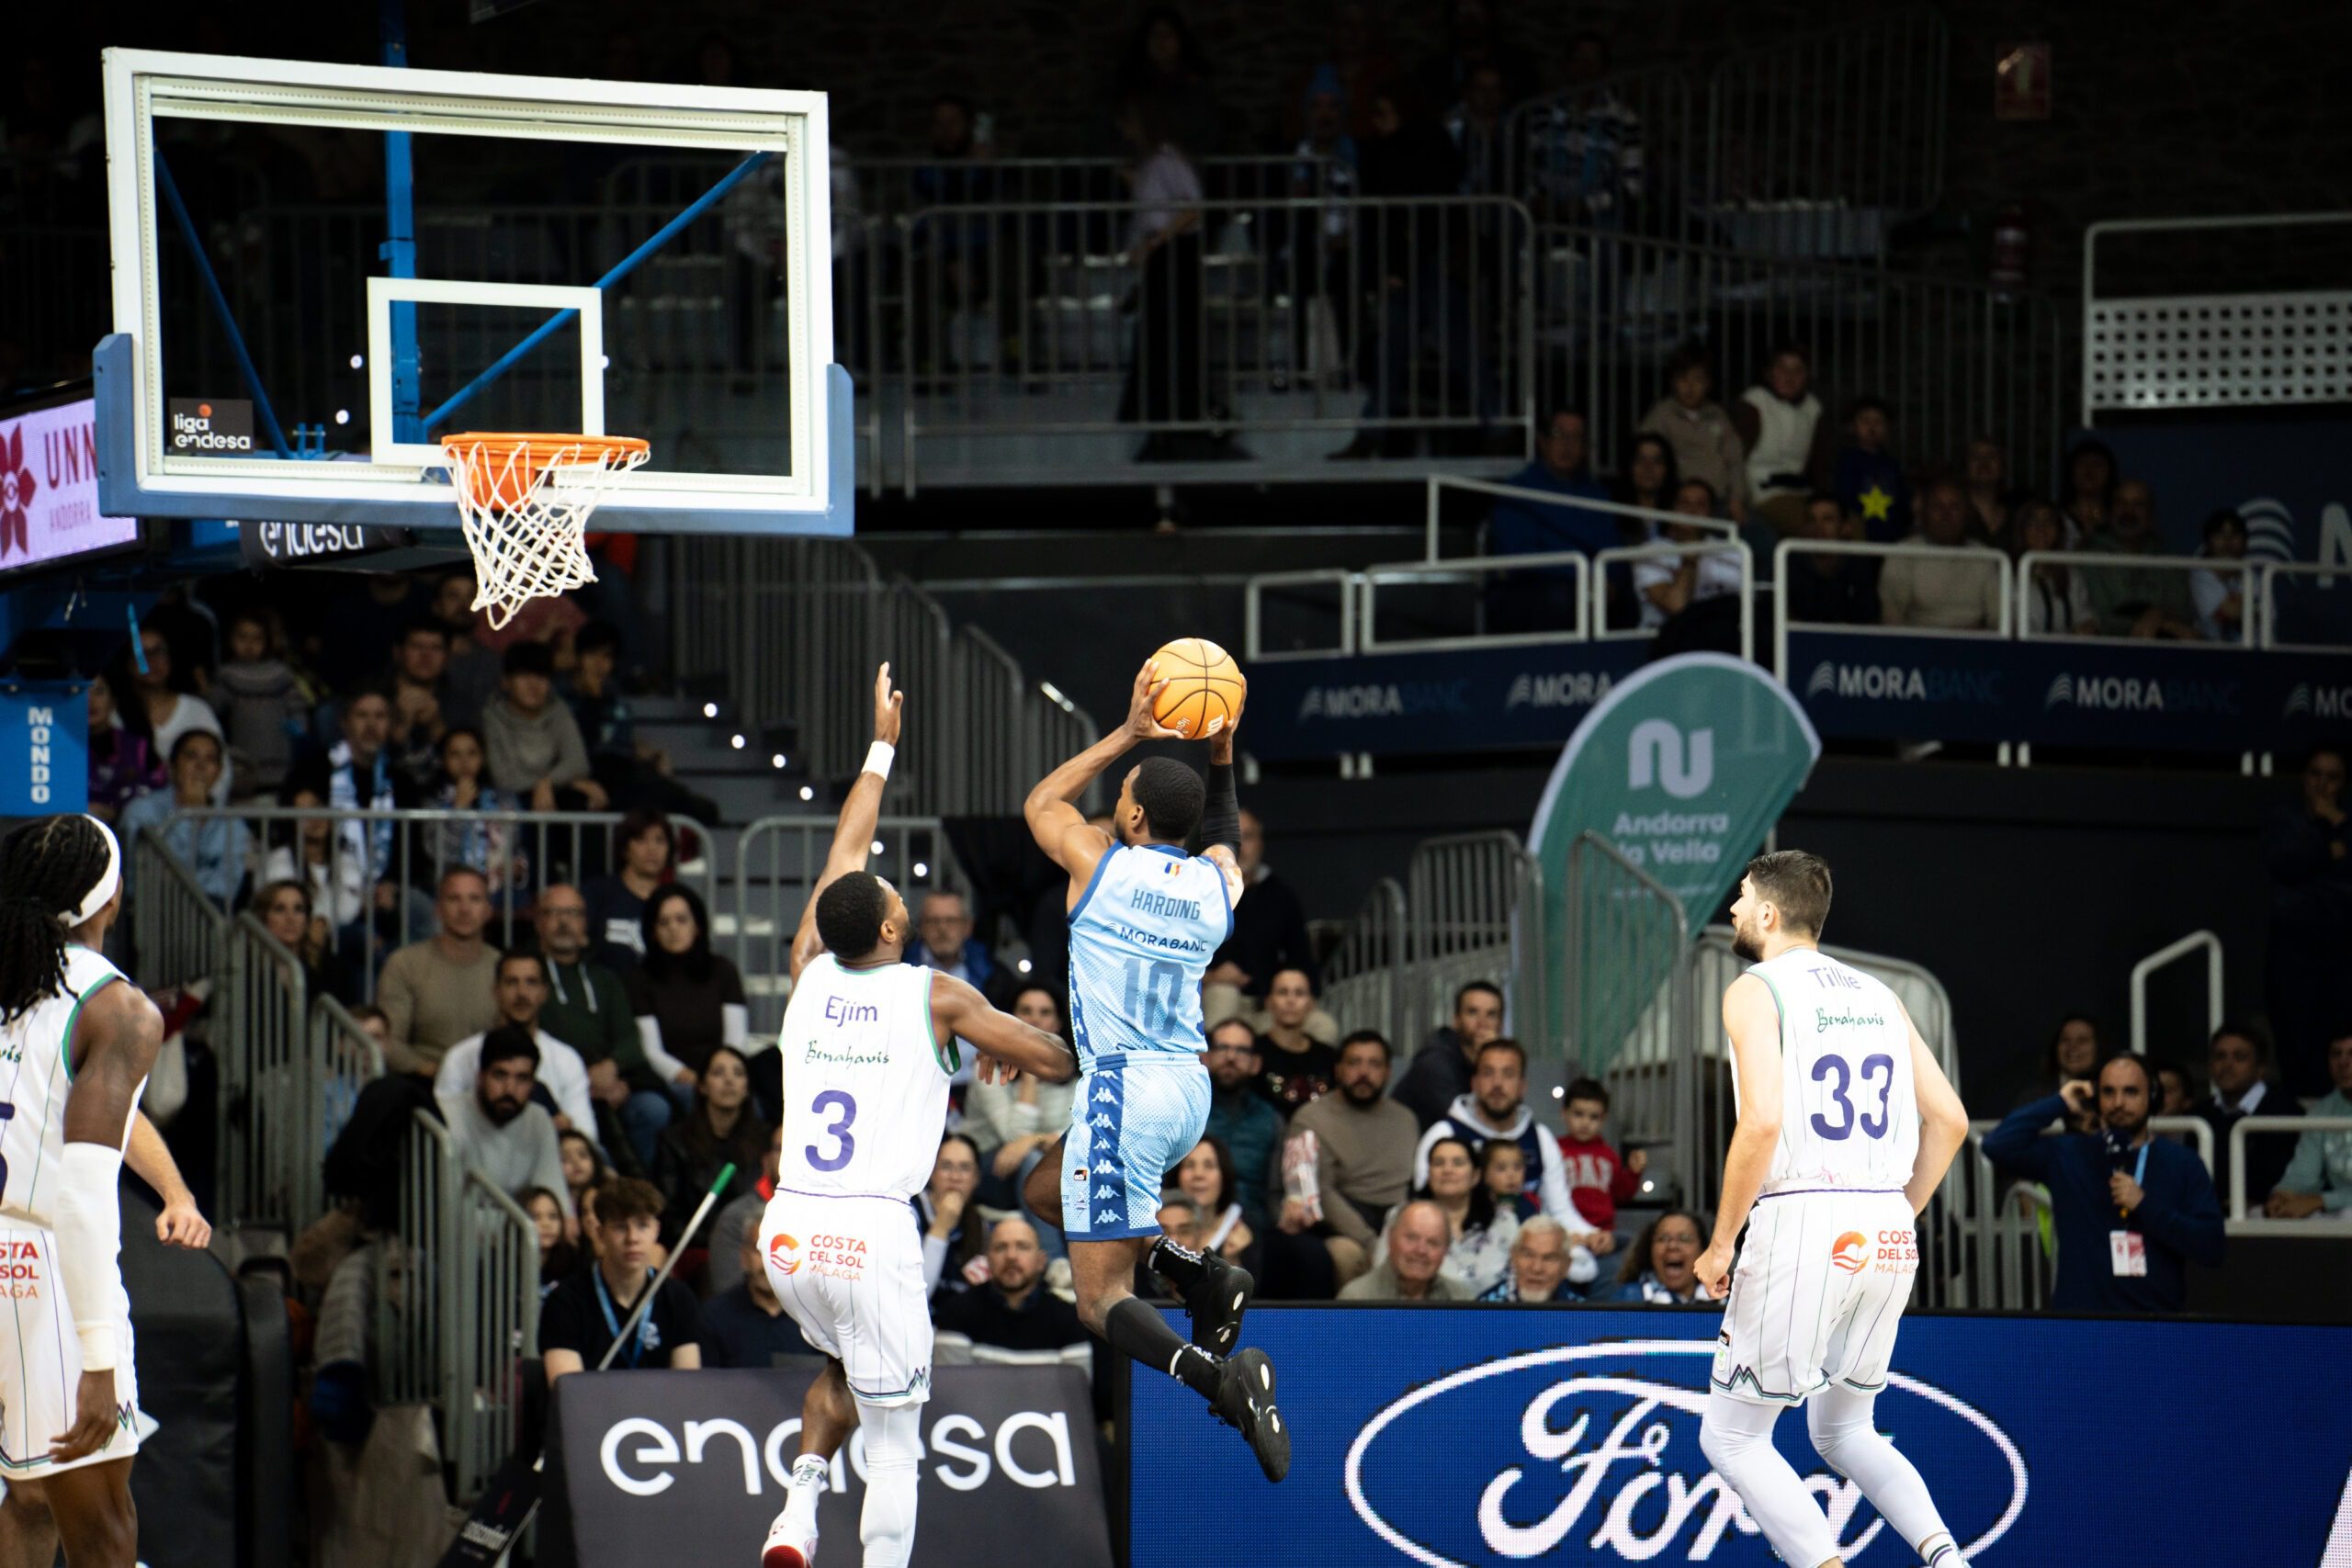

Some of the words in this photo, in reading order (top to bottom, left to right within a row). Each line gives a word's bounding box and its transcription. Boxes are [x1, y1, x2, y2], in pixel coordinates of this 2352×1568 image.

[174, 413, 209, 434] liga
[175, 431, 251, 450] endesa
[28, 705, 53, 805] MONDO
[1611, 810, 1730, 838] Andorra
[1130, 888, 1202, 920] HARDING
[1119, 926, 1209, 953] MORABANC
[1806, 966, 1862, 990] Tillie
[825, 995, 878, 1028] Ejim
[1123, 957, 1185, 1042] 10
[1810, 1053, 1894, 1142] 33
[805, 1089, 857, 1172] 3
[810, 1234, 867, 1255] COSTA
[1878, 1230, 1915, 1245] COS
[809, 1250, 831, 1264] DEL
[835, 1253, 865, 1269] SOL
[1877, 1247, 1903, 1260] DEL
[600, 1411, 1076, 1496] ensa
